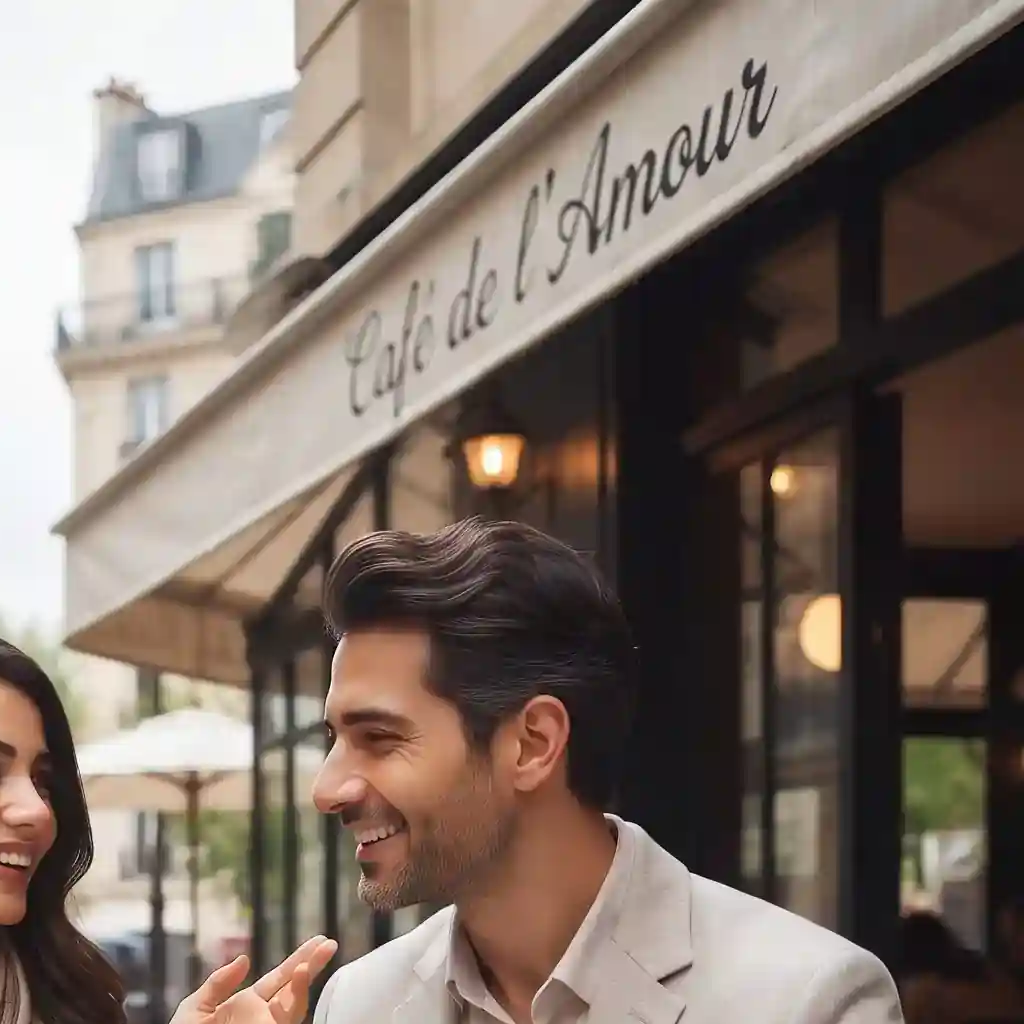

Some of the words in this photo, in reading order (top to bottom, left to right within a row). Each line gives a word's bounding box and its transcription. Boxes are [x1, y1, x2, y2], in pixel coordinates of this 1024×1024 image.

[345, 279, 434, 417] Café
[447, 236, 498, 349] de
[513, 57, 778, 303] l'Amour
